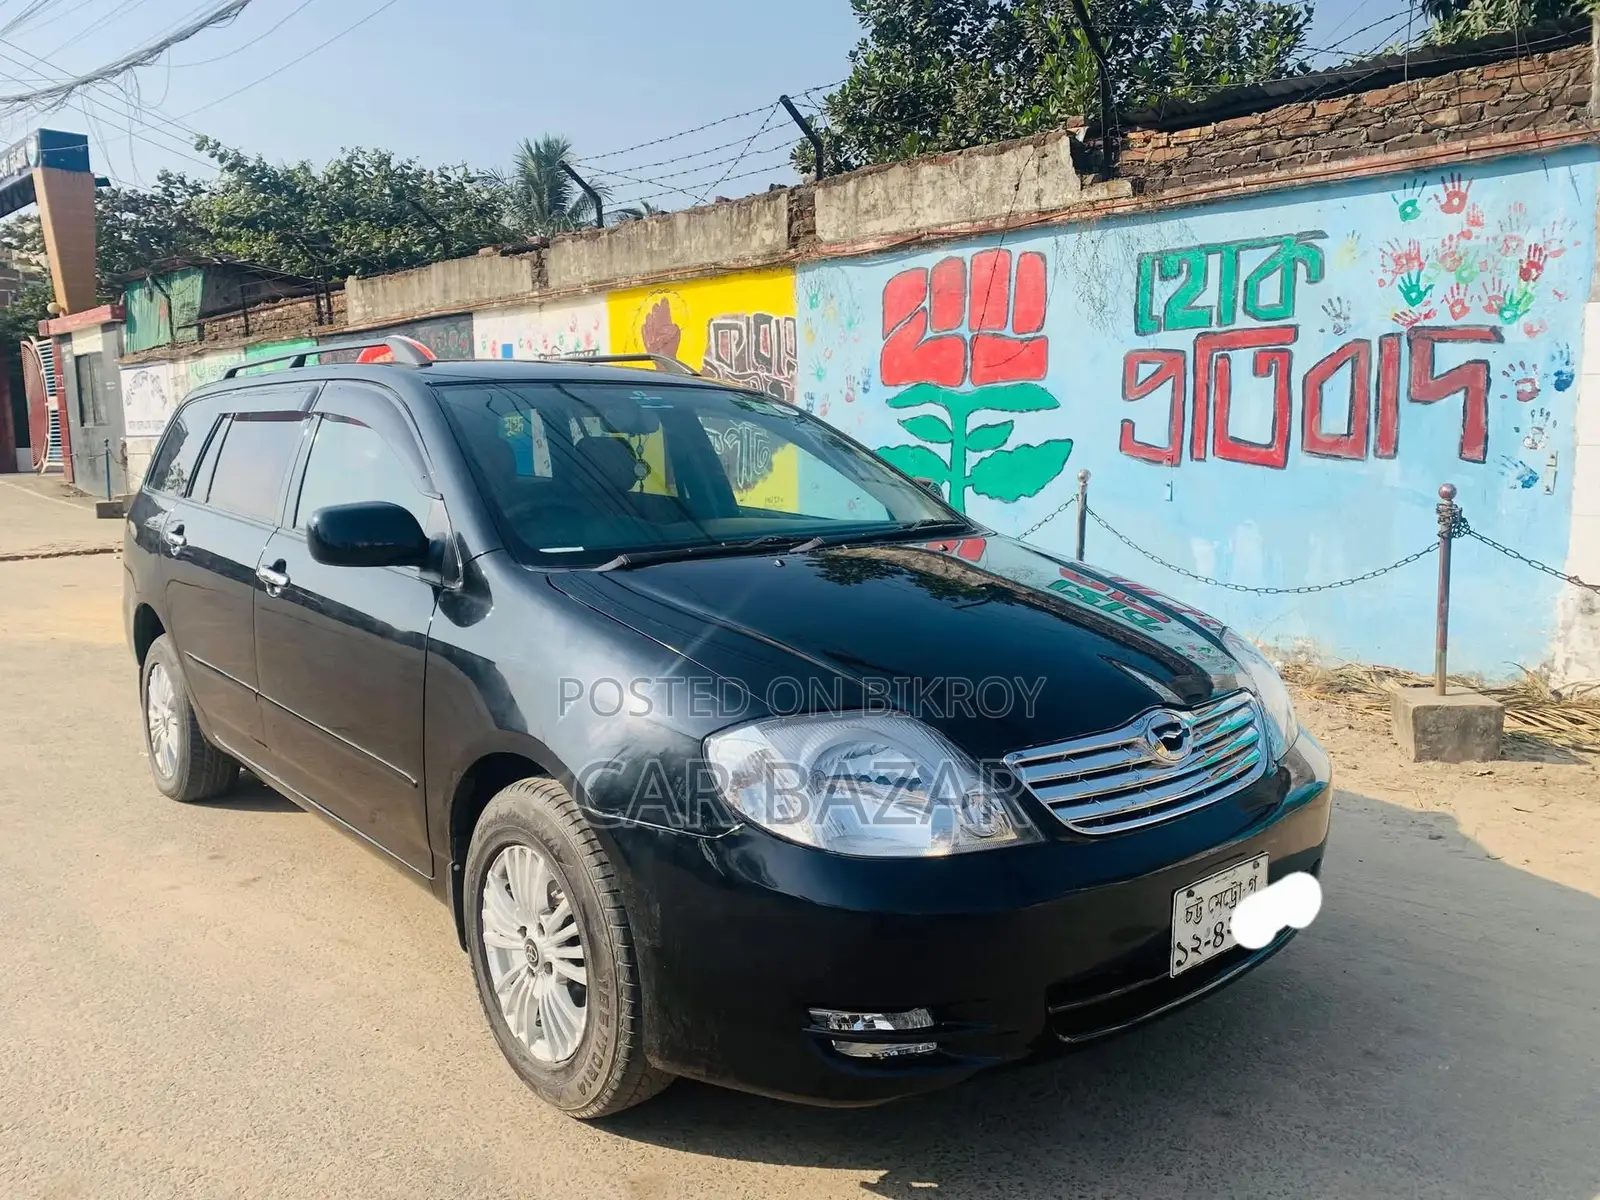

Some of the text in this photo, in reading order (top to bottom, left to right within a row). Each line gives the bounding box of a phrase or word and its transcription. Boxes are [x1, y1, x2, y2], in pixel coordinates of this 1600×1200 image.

[1134, 229, 1329, 336] হোক
[1119, 324, 1505, 470] প্রতিবাদ
[1175, 916, 1232, 968] ১২-৪
